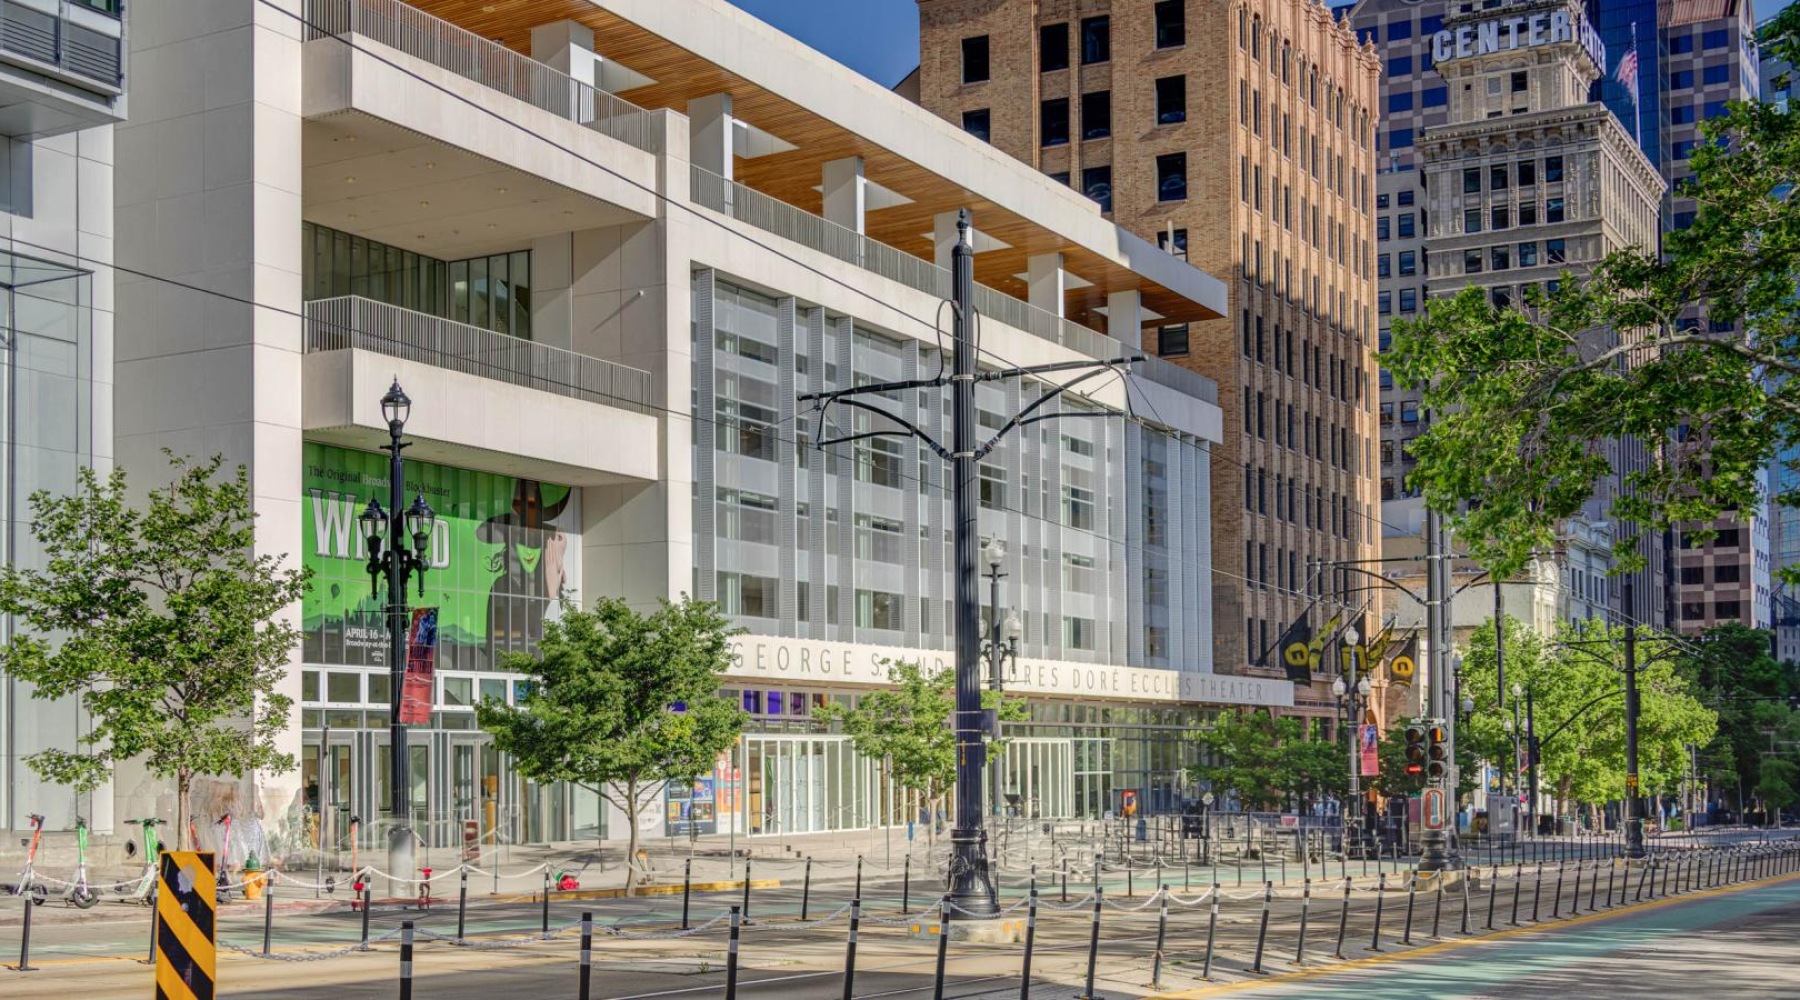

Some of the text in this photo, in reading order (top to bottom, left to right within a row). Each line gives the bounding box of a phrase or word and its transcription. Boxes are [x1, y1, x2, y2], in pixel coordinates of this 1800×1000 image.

[1433, 10, 1572, 62] CENTER
[309, 465, 450, 498] The Original Broad Blockbuster
[309, 488, 451, 569] WICED
[346, 628, 368, 639] APRIL
[369, 629, 379, 640] 16
[732, 641, 852, 675] GEORGE
[871, 652, 882, 677] S.
[1072, 668, 1119, 692] DORÉ
[1131, 672, 1191, 696] ECCLES
[1201, 678, 1262, 701] THEATER
